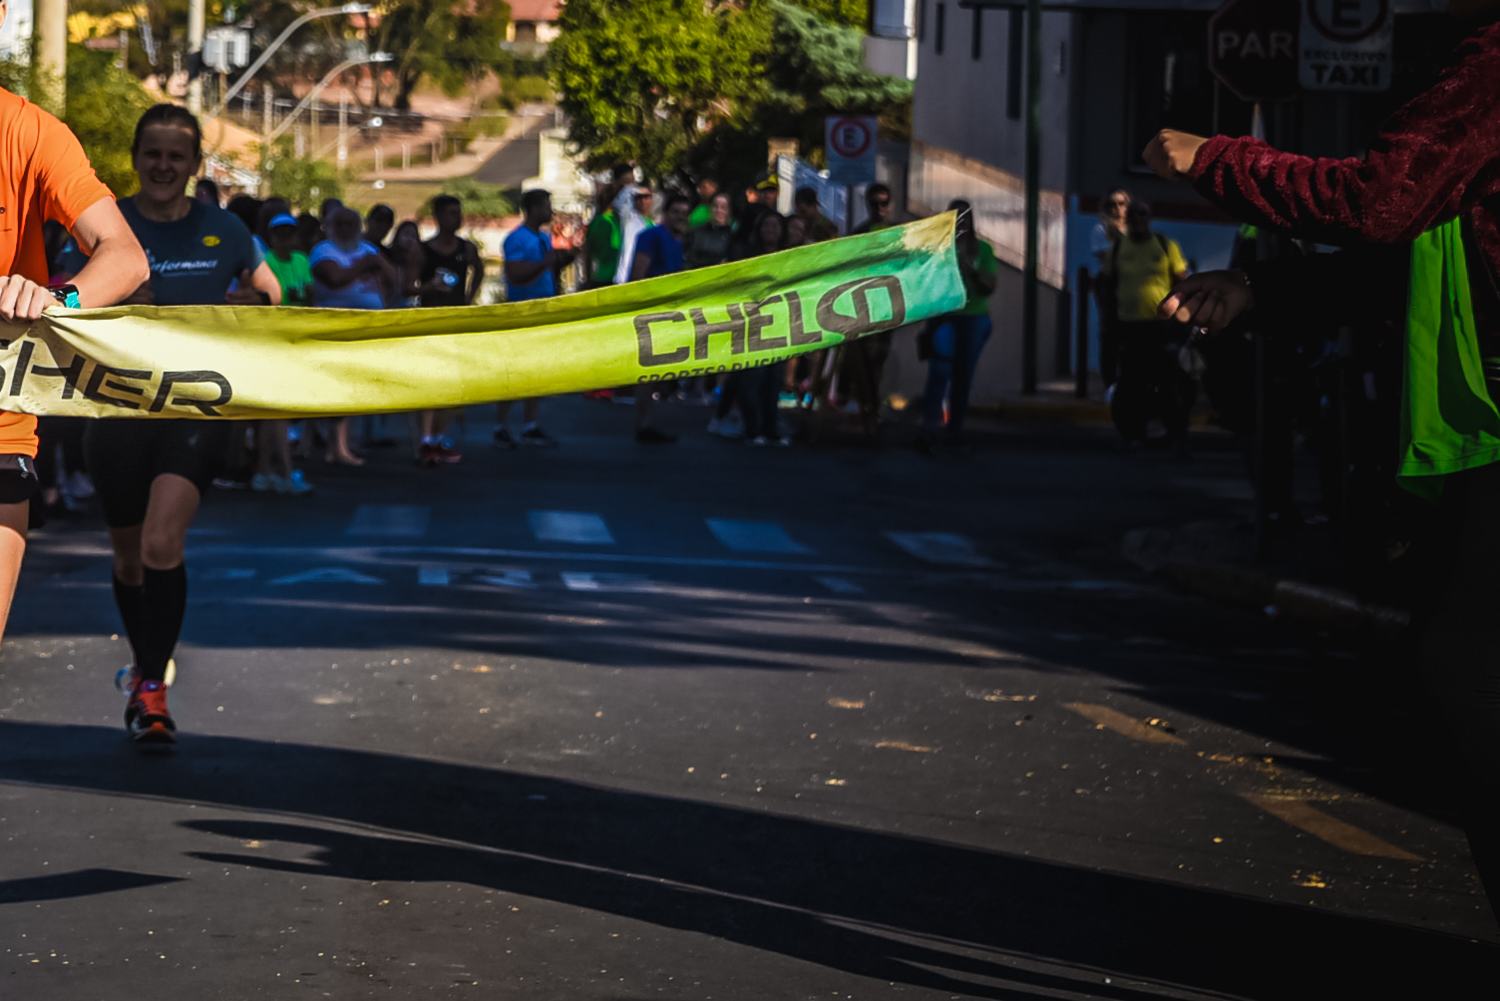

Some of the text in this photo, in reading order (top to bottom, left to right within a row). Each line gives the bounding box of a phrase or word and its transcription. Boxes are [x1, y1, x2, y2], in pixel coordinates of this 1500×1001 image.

[1216, 30, 1295, 60] PAR
[1304, 49, 1386, 63] EXCLUSIVO
[1309, 64, 1380, 86] TAXI
[633, 275, 906, 368] CHELO
